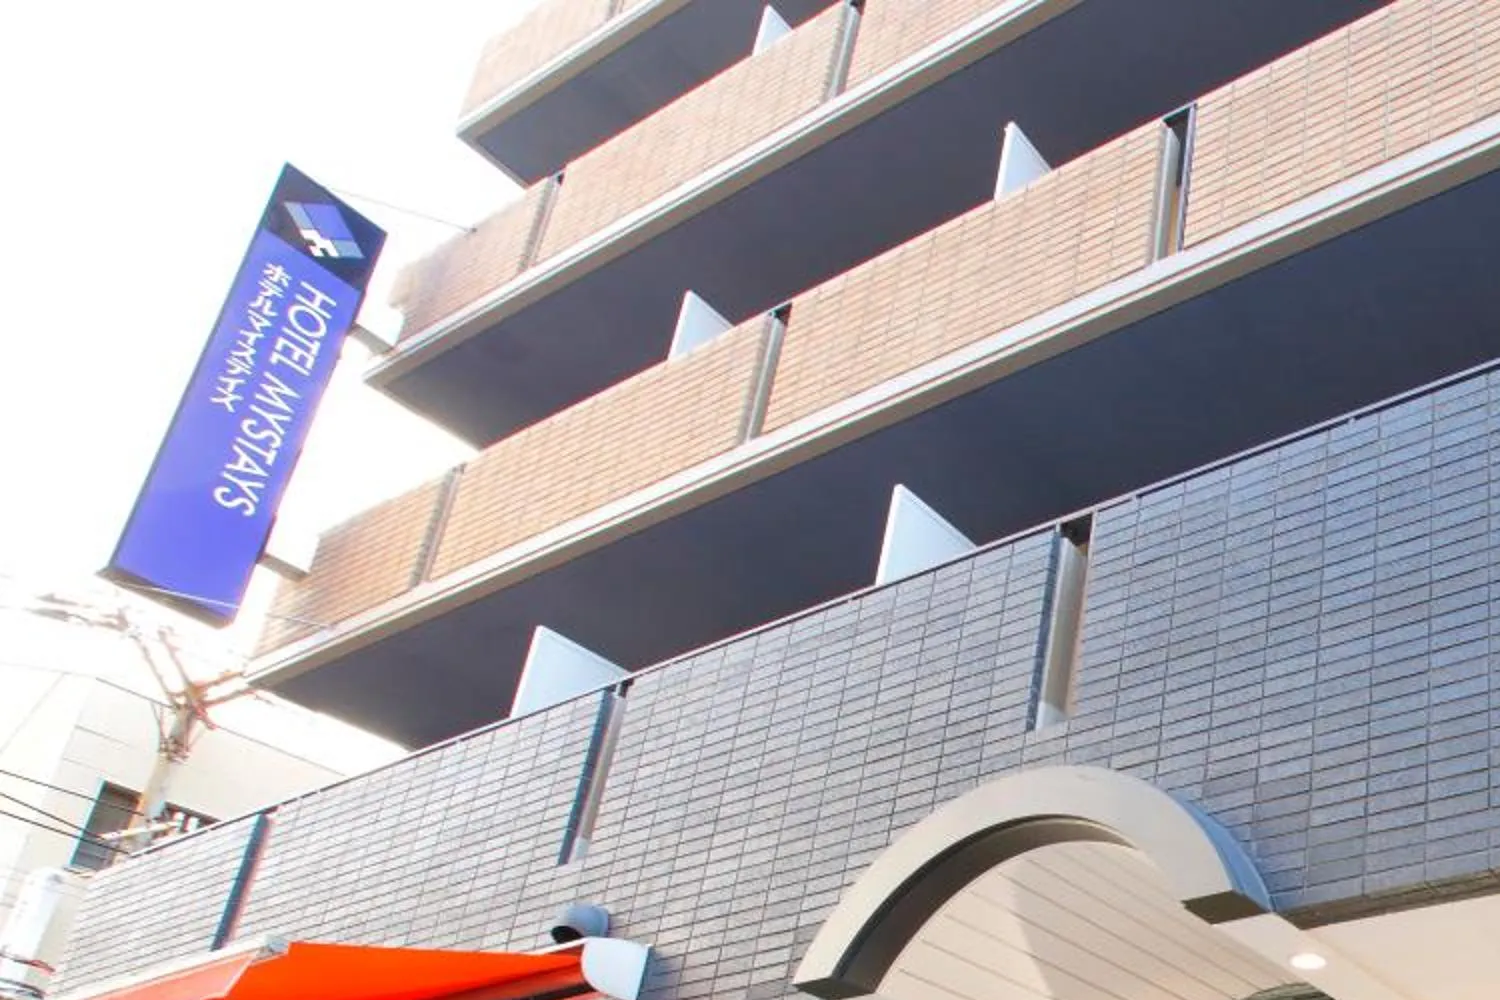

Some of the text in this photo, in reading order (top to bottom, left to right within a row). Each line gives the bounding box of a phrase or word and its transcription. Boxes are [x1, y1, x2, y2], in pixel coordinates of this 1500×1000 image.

[210, 263, 291, 412] ホテルマイステイズ
[213, 281, 337, 518] HOTEL MYSTAYS
